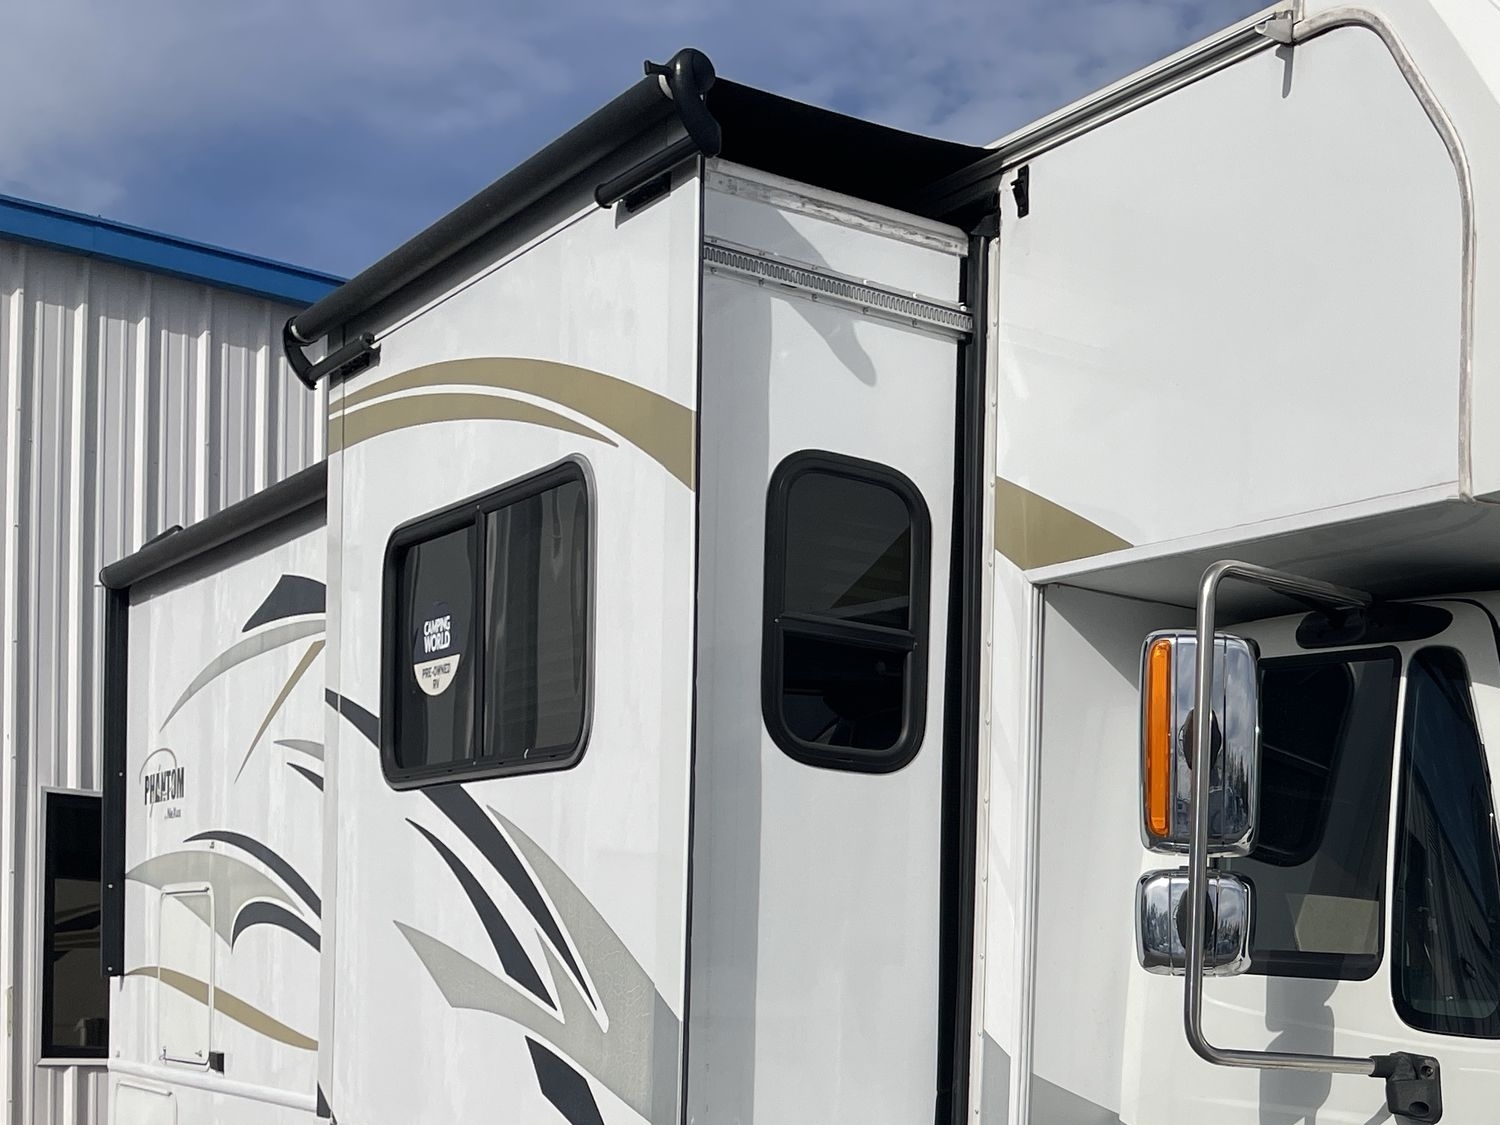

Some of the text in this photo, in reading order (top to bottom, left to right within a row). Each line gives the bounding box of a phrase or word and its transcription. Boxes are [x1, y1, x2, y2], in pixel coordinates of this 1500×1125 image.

[423, 615, 451, 636] CAMPING
[423, 631, 451, 654] WORLD
[422, 663, 451, 679] PRE-OWNED
[144, 766, 185, 806] PHANTOM
